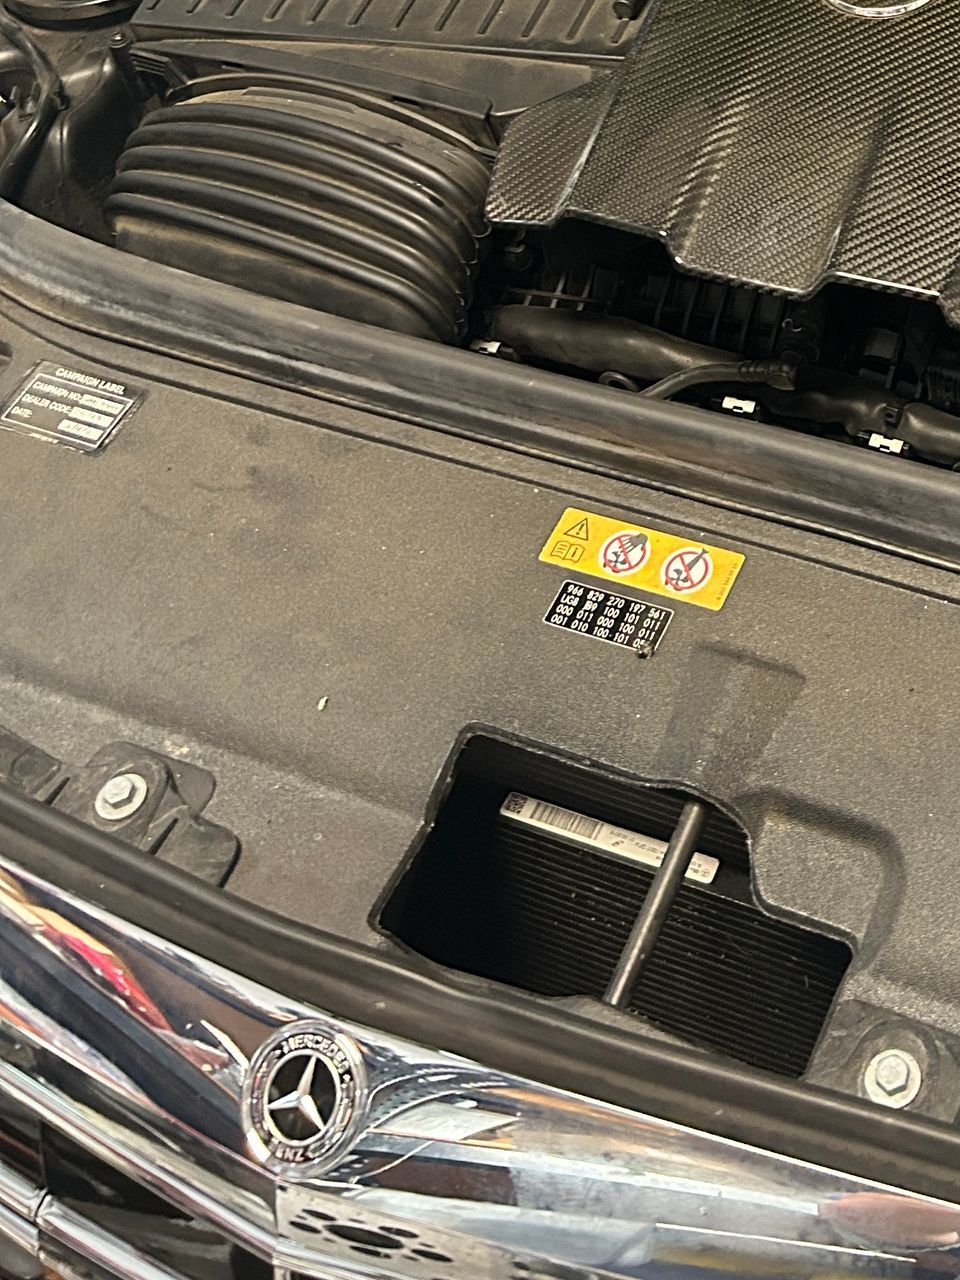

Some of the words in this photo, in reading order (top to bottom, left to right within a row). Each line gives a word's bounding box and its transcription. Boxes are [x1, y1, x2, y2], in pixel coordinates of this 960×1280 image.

[55, 367, 100, 387] CAMPAIGN
[98, 379, 125, 395] LABEL
[21, 393, 51, 408] DEALER
[567, 584, 584, 596] 966
[586, 590, 605, 602] 829
[606, 596, 625, 609] 270
[629, 602, 647, 614] 197
[647, 609, 666, 620] 561
[603, 606, 620, 619] 100
[624, 612, 640, 624] 101
[643, 619, 661, 630] 011
[550, 613, 568, 626] 001
[570, 620, 589, 632] 010
[592, 626, 609, 638] 100
[613, 632, 630, 645] 101
[556, 604, 574, 617] 000
[576, 610, 594, 622] 011
[596, 616, 615, 628] 000
[619, 622, 635, 634] 100
[638, 628, 656, 640] 011
[280, 1032, 352, 1075] MERCEDES
